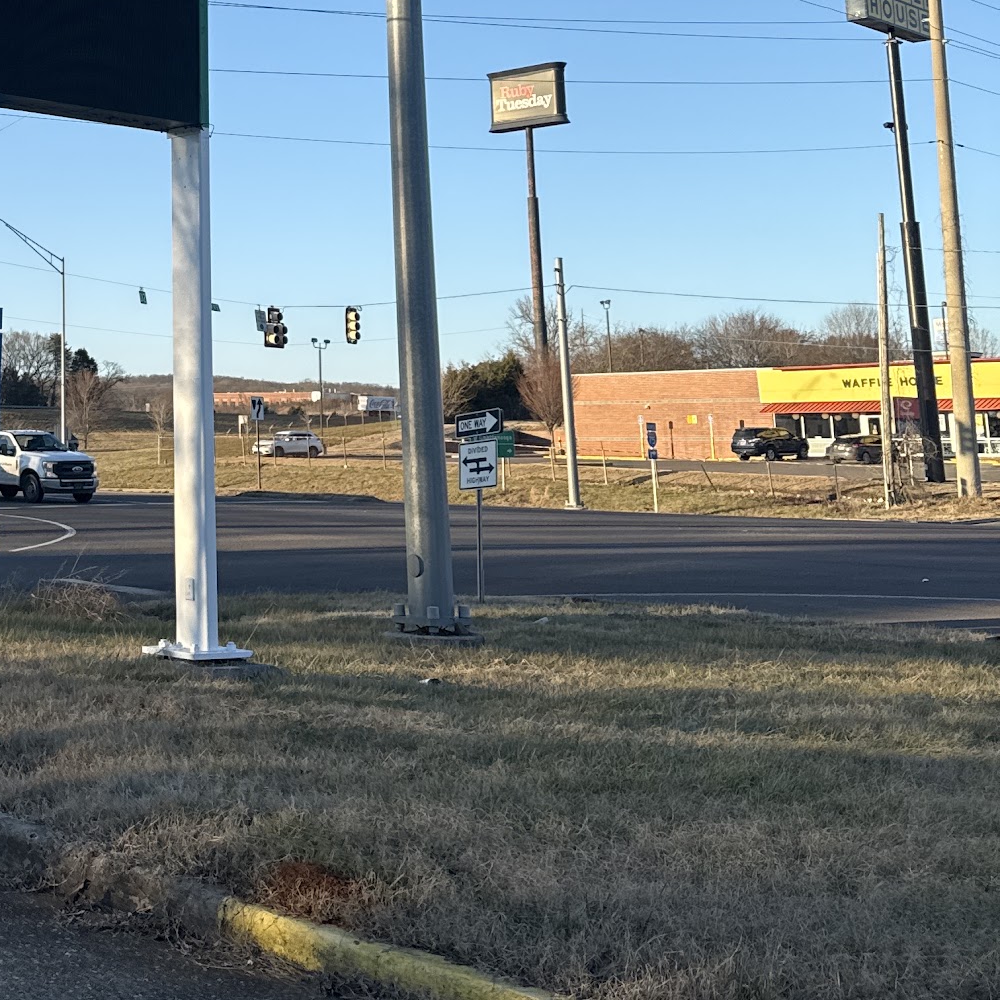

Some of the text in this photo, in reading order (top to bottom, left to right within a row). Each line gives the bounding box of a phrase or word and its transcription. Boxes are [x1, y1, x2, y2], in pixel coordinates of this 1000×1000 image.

[499, 84, 534, 98] Ruby
[495, 94, 552, 112] Tuesday
[460, 418, 487, 431] ONE WAY
[467, 445, 489, 455] DIVIDED
